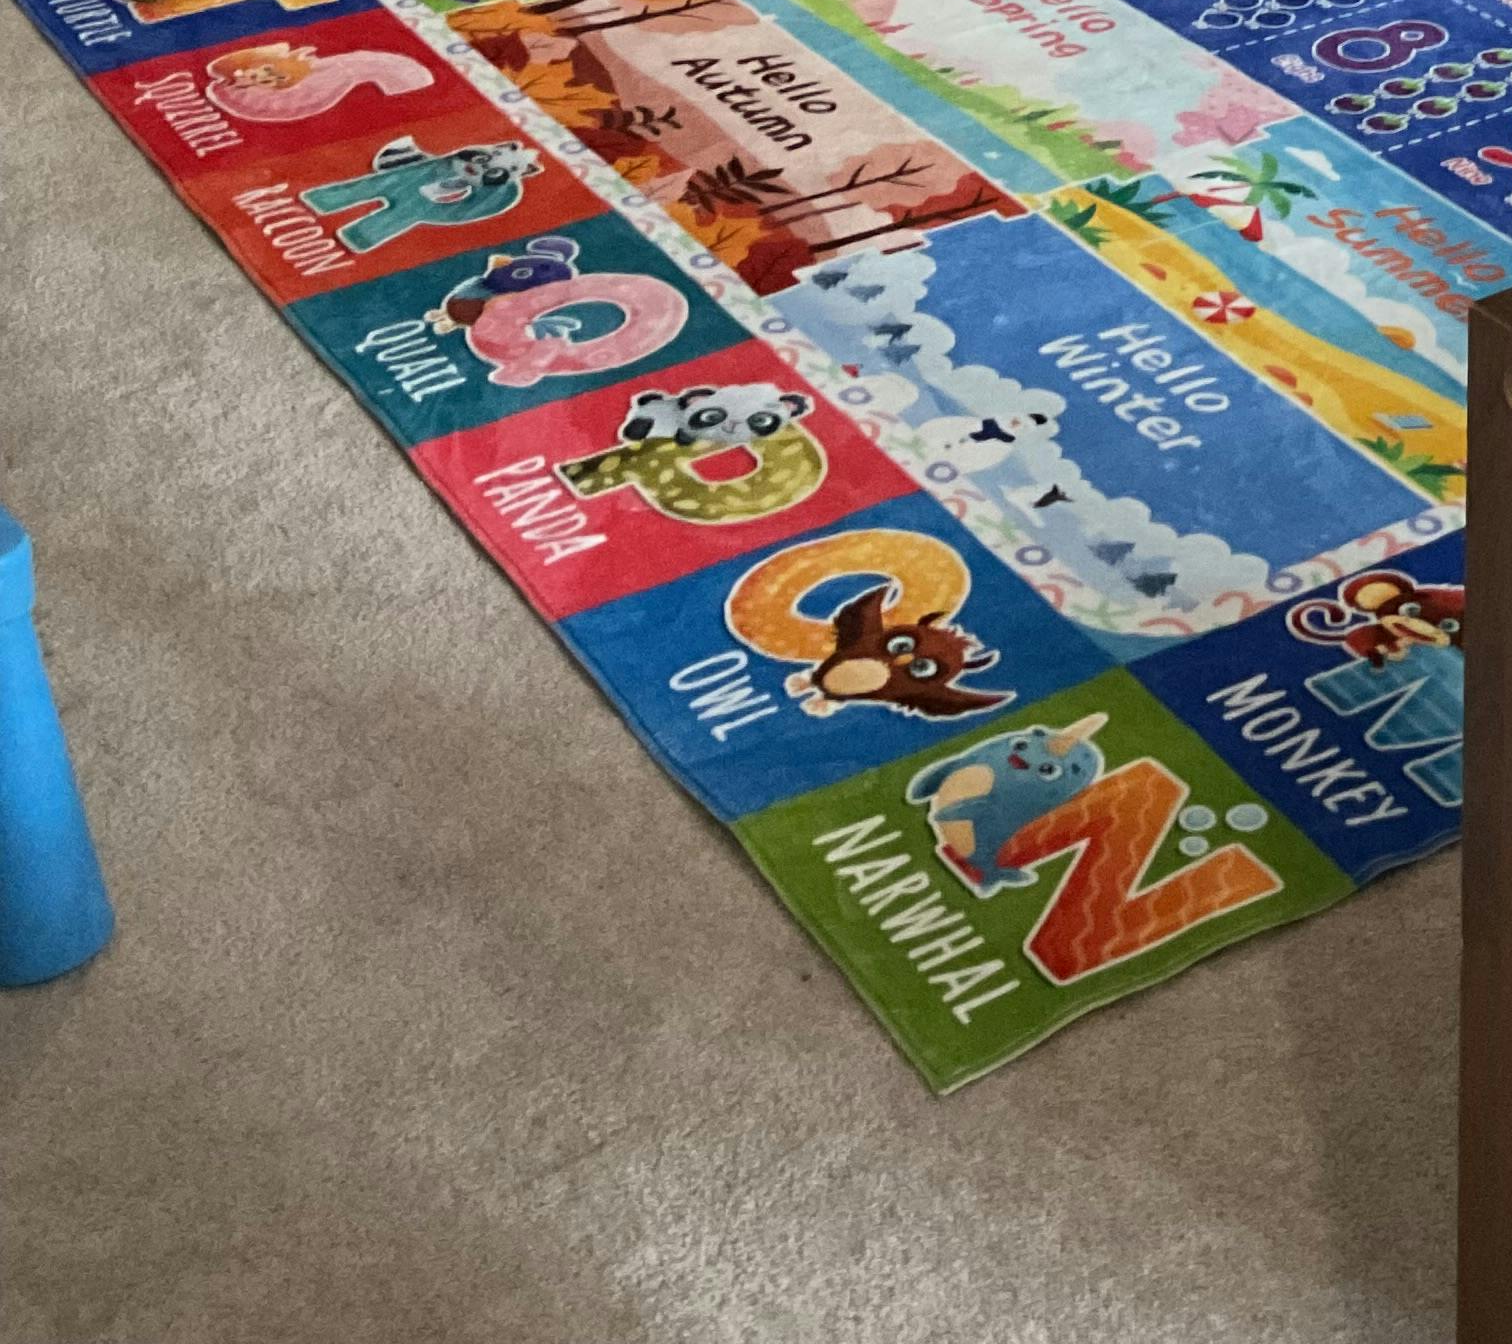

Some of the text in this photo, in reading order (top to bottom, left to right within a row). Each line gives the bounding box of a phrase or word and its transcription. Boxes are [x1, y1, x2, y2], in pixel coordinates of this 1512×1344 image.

[735, 53, 838, 117] Hello
[1311, 19, 1450, 74] 8
[133, 70, 244, 159] SQUIRREL
[670, 56, 812, 154] Autumn
[232, 182, 358, 275] RACCOON
[1305, 207, 1473, 318] Summe
[1374, 205, 1506, 283] Hello
[355, 319, 467, 404] QUAIL
[1038, 333, 1203, 453] Winter
[1097, 322, 1231, 413] Hello
[472, 455, 608, 567] PANDA
[668, 648, 778, 743] OWL
[1205, 673, 1408, 828] MONKEY
[997, 756, 1285, 986] N
[812, 814, 1022, 1026] NARWHAL
